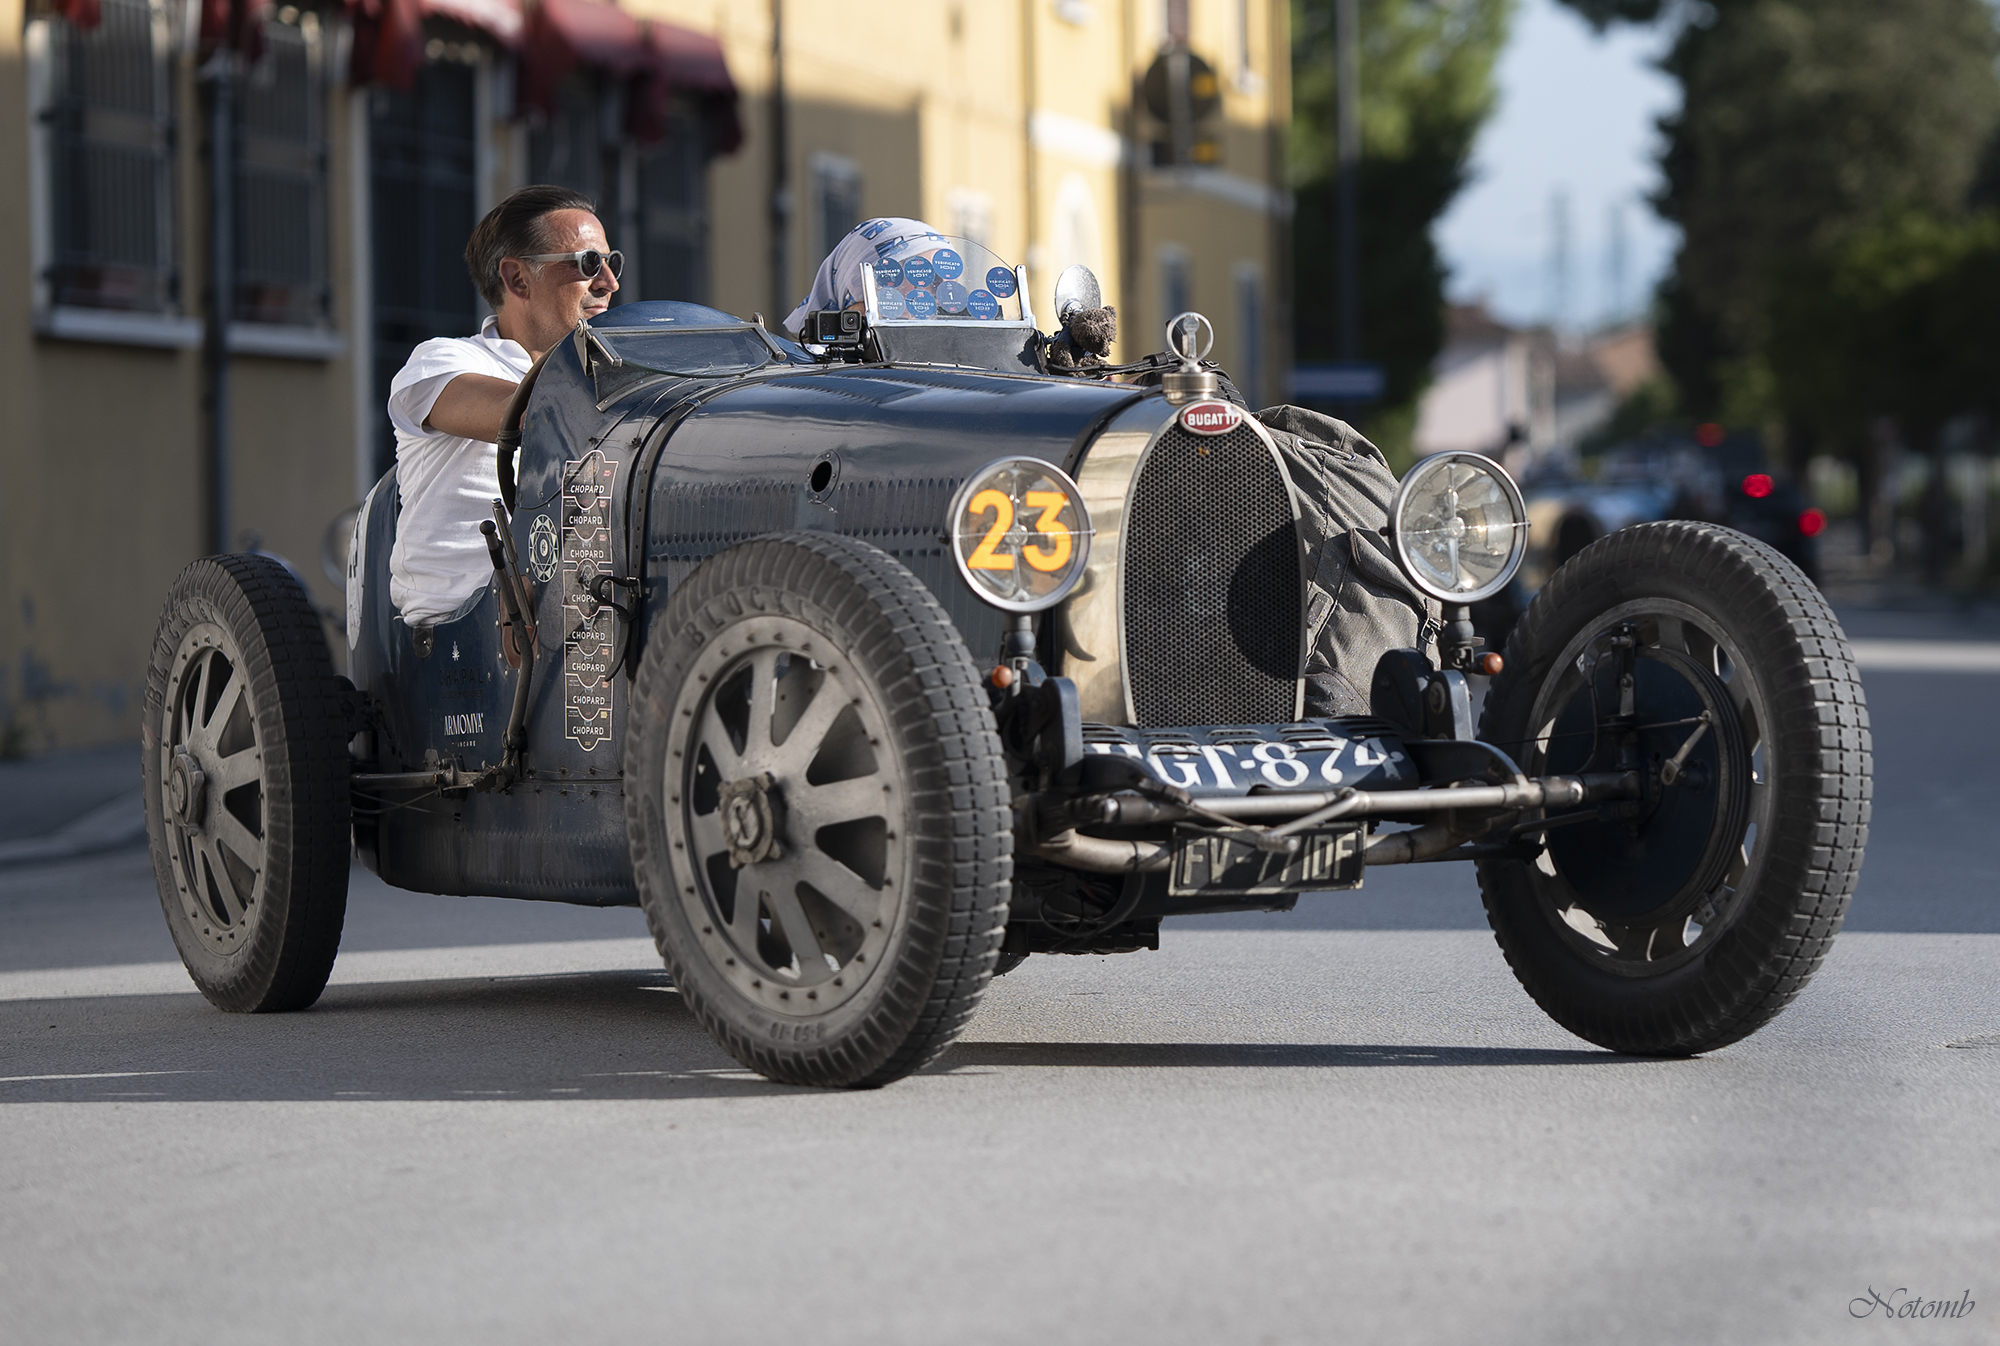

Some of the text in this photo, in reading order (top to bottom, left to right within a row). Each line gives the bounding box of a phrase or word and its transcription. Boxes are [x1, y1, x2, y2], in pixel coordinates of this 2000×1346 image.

[948, 291, 954, 301] 1
[1187, 413, 1235, 426] BUGATTI
[570, 484, 605, 494] CHOPARD
[568, 515, 603, 525] CHOPARD
[967, 489, 1073, 572] 23
[570, 549, 605, 559] CHOPARD
[571, 594, 606, 604] CHOPA
[571, 631, 606, 641] CHOPARD
[572, 662, 606, 673] CHOPARD
[438, 668, 484, 686] CHAPAL
[572, 695, 606, 705] CHOPARD
[572, 726, 604, 735] CHOPARD
